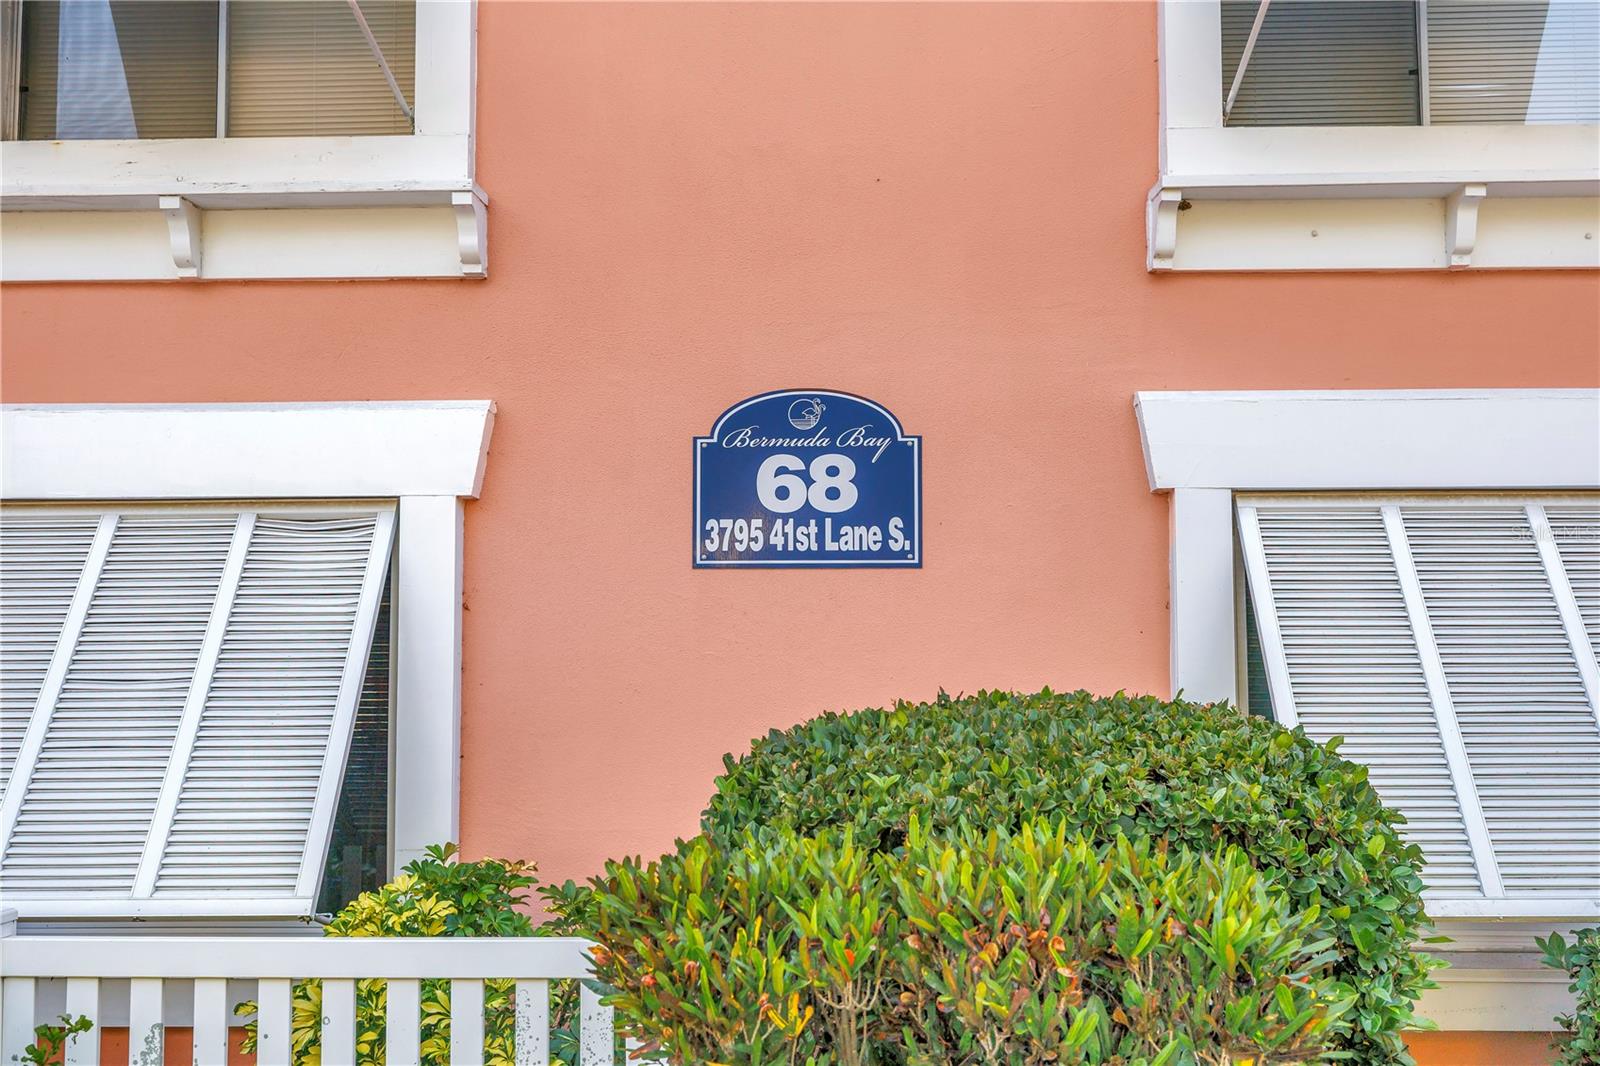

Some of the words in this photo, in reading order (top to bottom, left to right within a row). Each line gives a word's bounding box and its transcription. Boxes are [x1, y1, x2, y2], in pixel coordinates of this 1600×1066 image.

[722, 425, 831, 449] Bermuda
[836, 424, 892, 463] Bay
[756, 453, 858, 513] 68
[705, 518, 764, 552] 3795
[769, 518, 818, 552] 41st
[824, 517, 882, 552] Lane
[888, 516, 911, 552] S.
